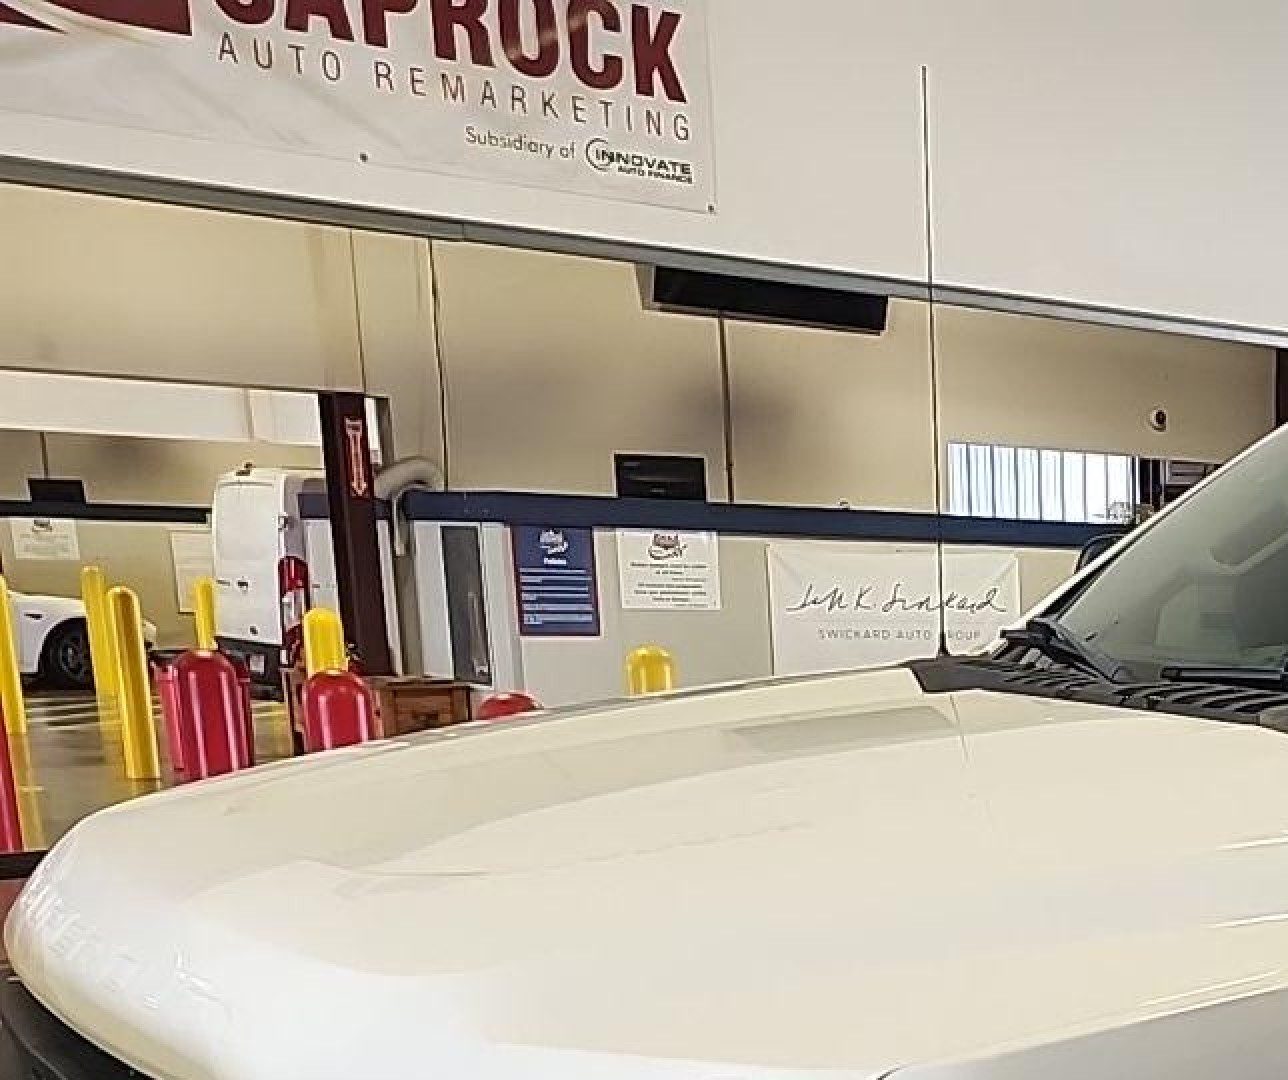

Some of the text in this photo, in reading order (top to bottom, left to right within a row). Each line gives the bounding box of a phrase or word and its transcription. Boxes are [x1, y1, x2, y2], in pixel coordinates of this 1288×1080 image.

[218, 32, 690, 140] AUTO REMARKETING
[465, 126, 576, 159] Subsidiary of
[595, 149, 692, 174] INNOVATE
[895, 629, 931, 641] AUTO
